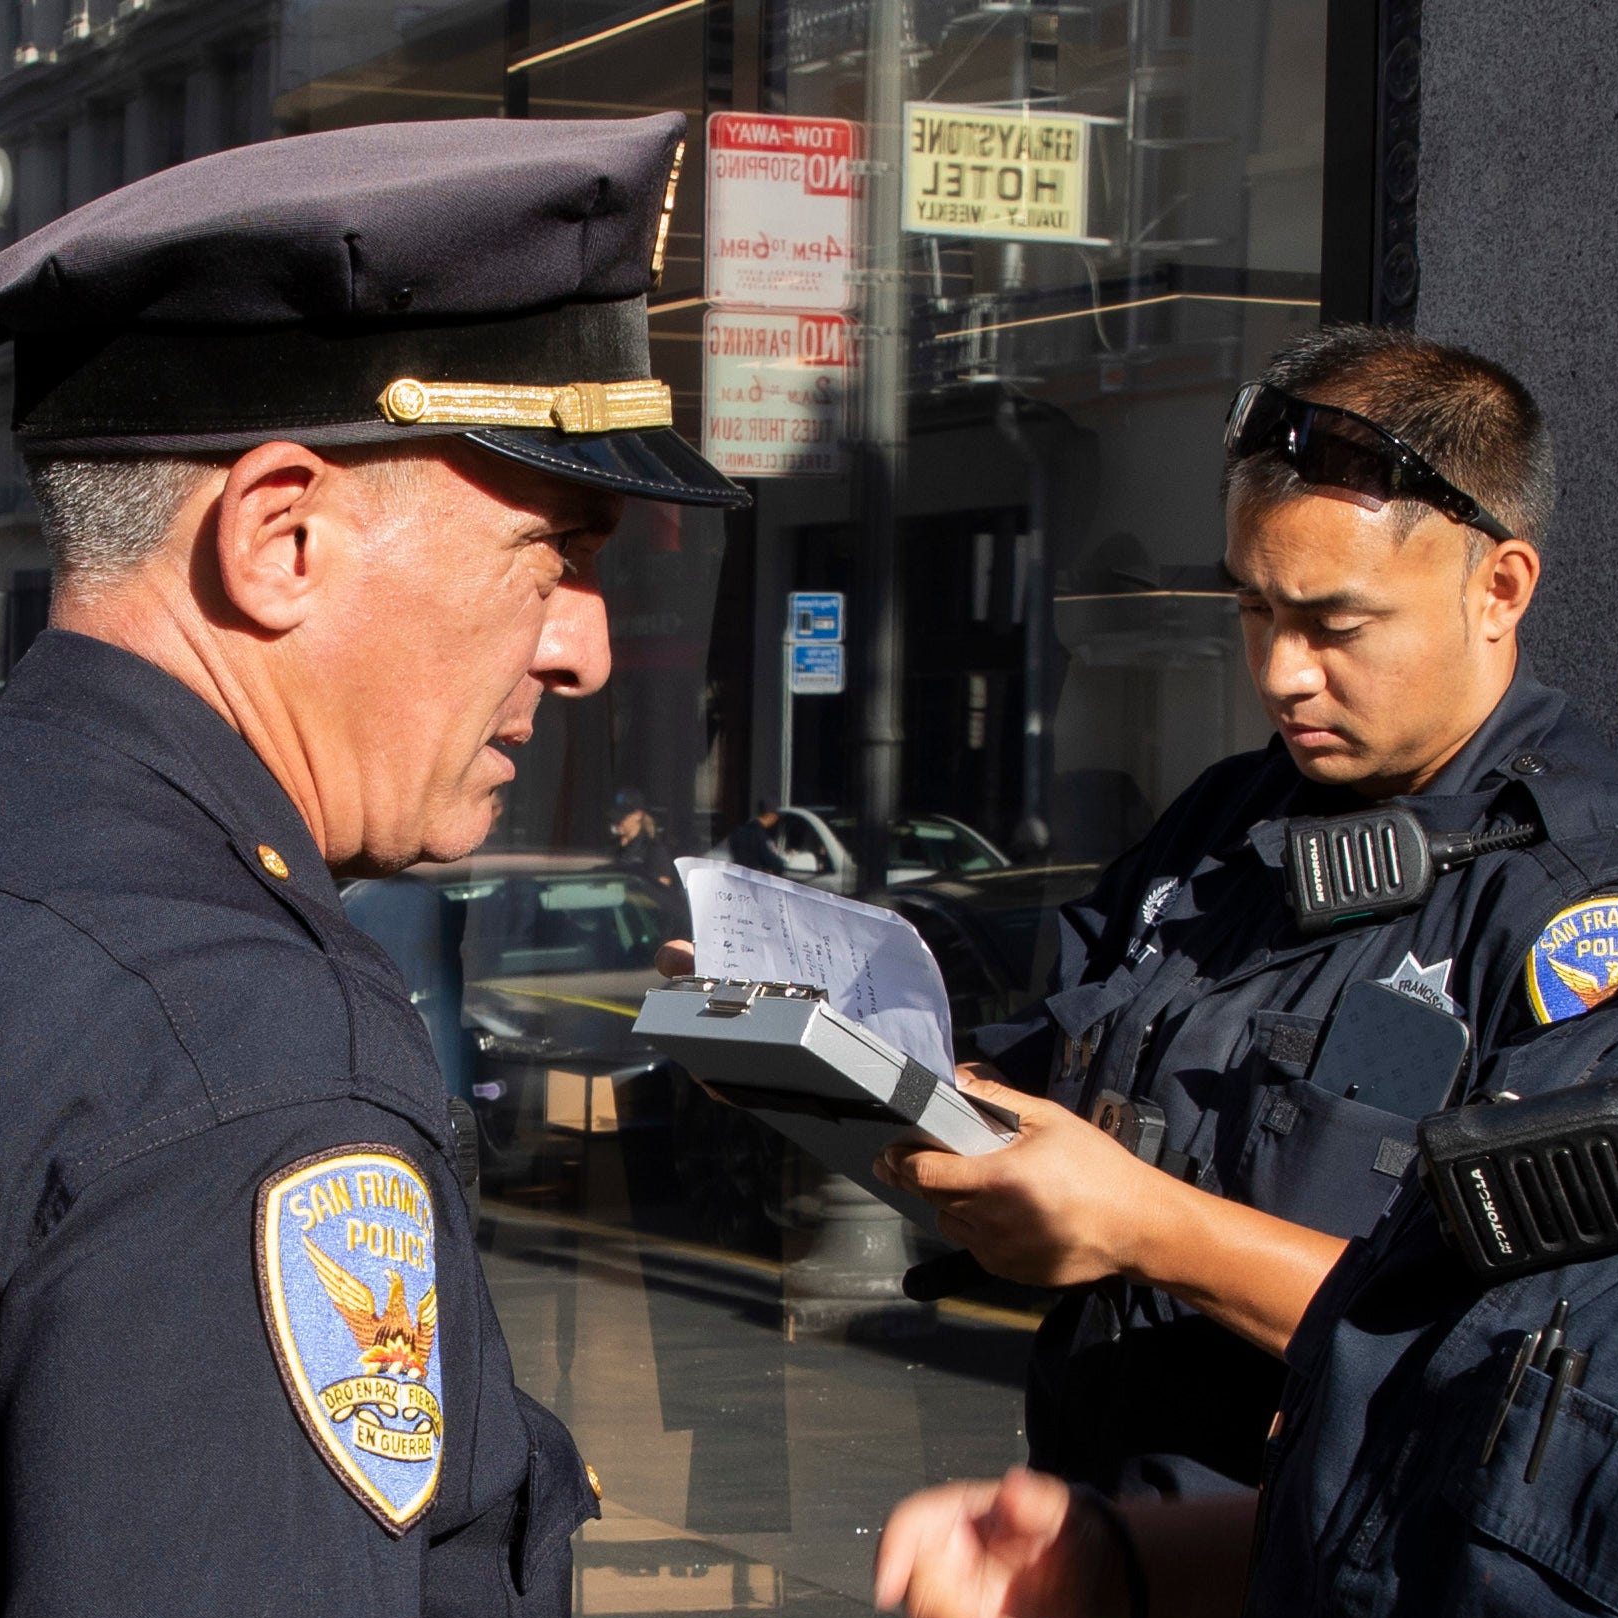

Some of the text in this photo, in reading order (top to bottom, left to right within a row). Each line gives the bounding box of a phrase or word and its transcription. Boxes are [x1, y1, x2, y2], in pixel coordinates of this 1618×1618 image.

[1309, 837, 1325, 902] MOTOROLA
[1539, 917, 1580, 955] SAN
[288, 1174, 353, 1231] SAN
[346, 1217, 428, 1272] POLICE
[324, 1384, 353, 1409] ORO
[356, 1381, 372, 1398] EN
[375, 1382, 398, 1402] PAZ
[357, 1424, 432, 1456] EN GUERRA
